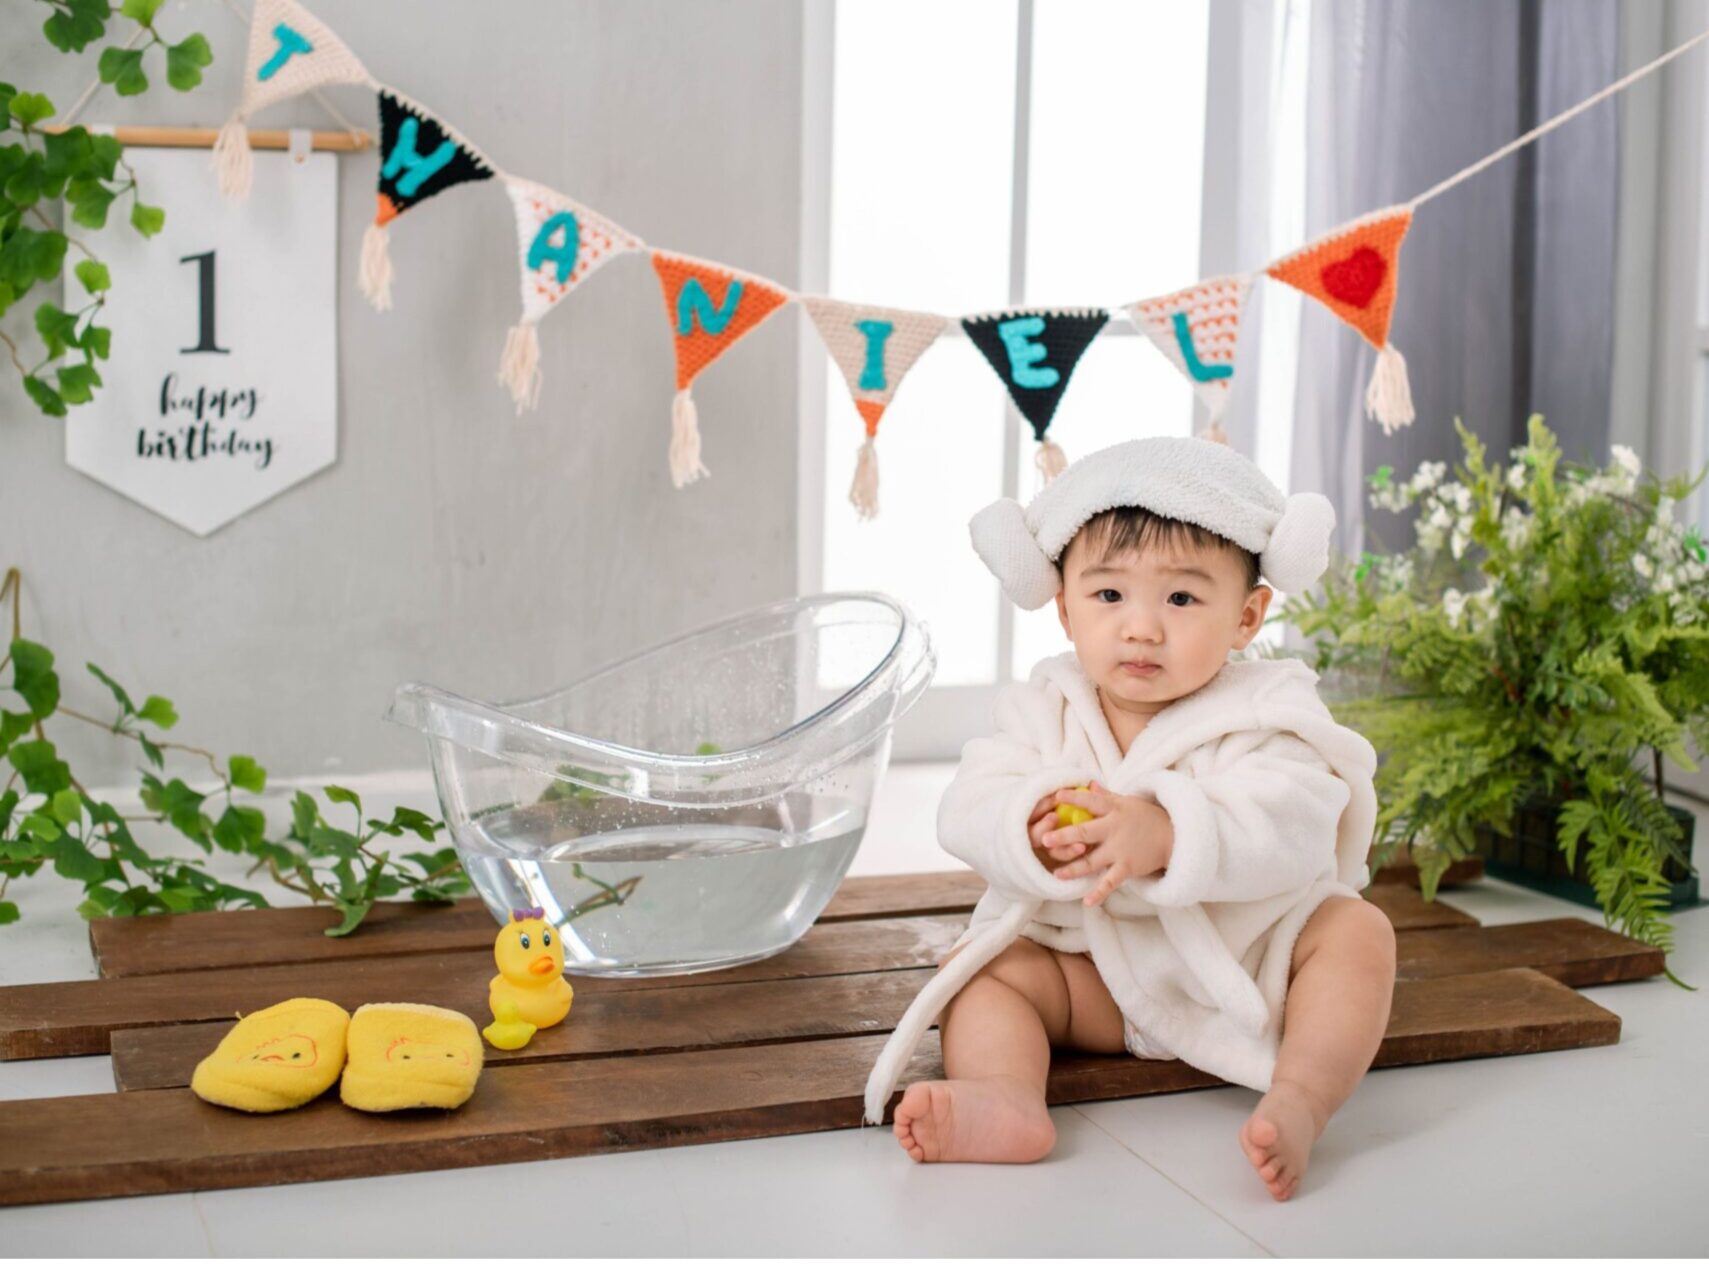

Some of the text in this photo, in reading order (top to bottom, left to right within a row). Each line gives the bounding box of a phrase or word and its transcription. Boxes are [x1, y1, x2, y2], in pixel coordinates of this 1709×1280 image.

[178, 249, 231, 355] 1
[159, 372, 261, 423] happy
[136, 421, 278, 469] birthday
